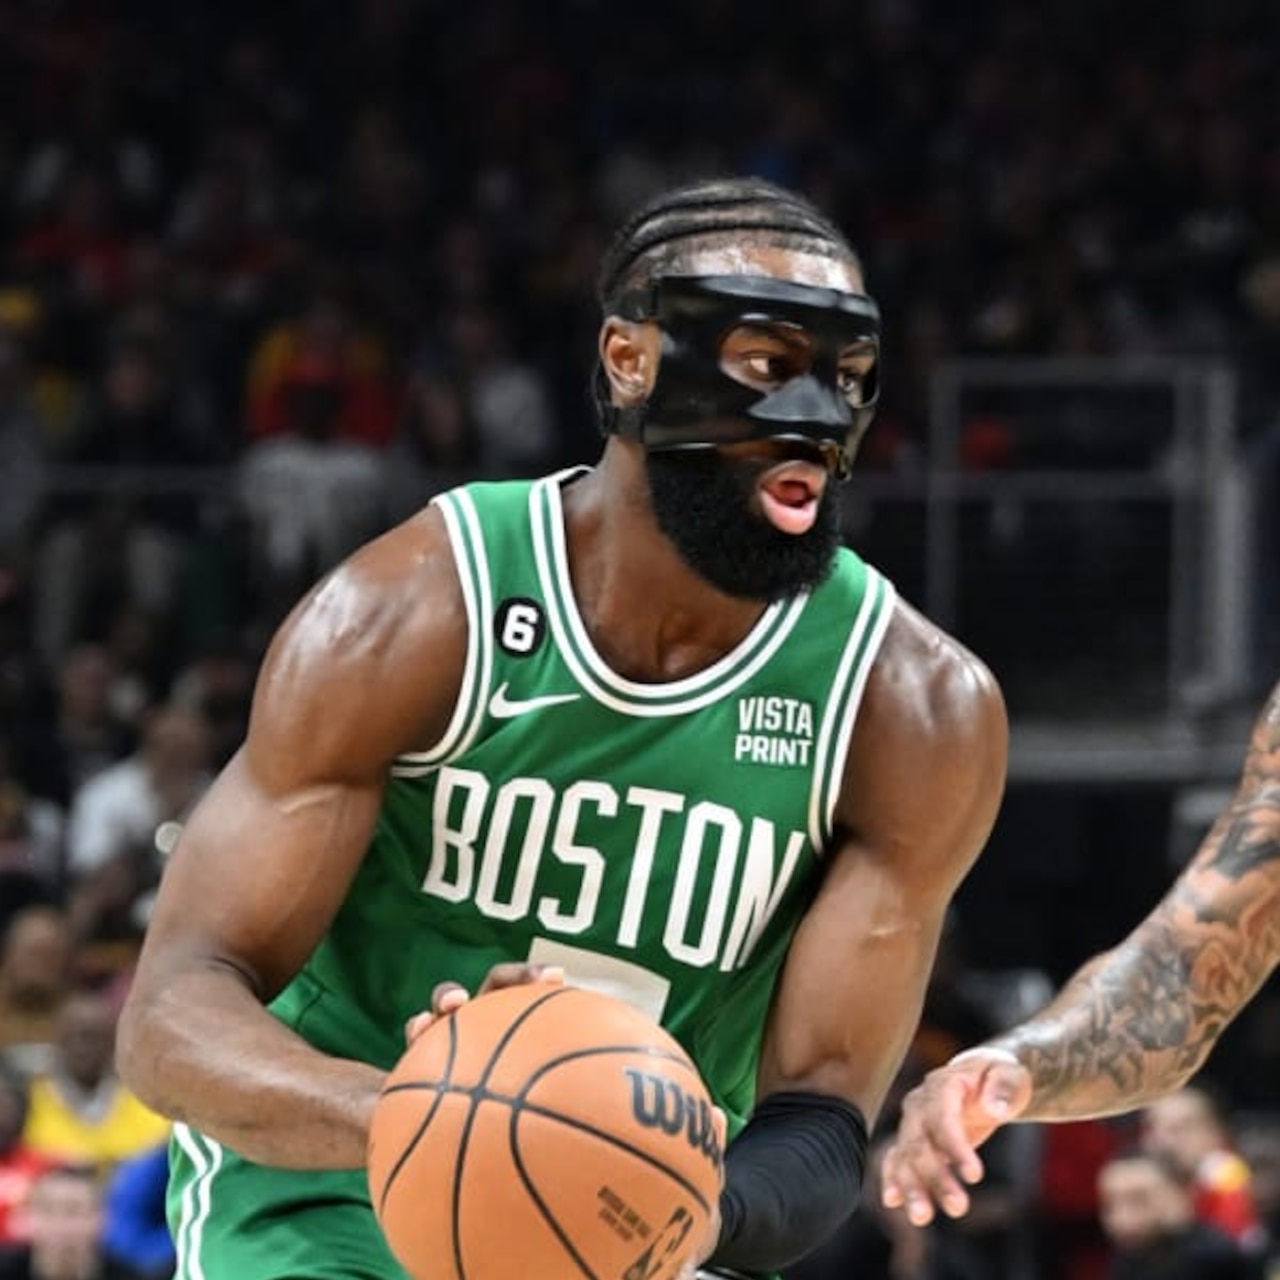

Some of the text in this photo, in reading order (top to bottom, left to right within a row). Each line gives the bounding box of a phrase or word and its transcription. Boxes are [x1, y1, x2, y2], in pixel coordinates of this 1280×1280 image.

[501, 604, 538, 652] 6
[738, 697, 813, 738] VISTA
[735, 737, 812, 766] PRINT
[422, 766, 806, 972] BOSTON
